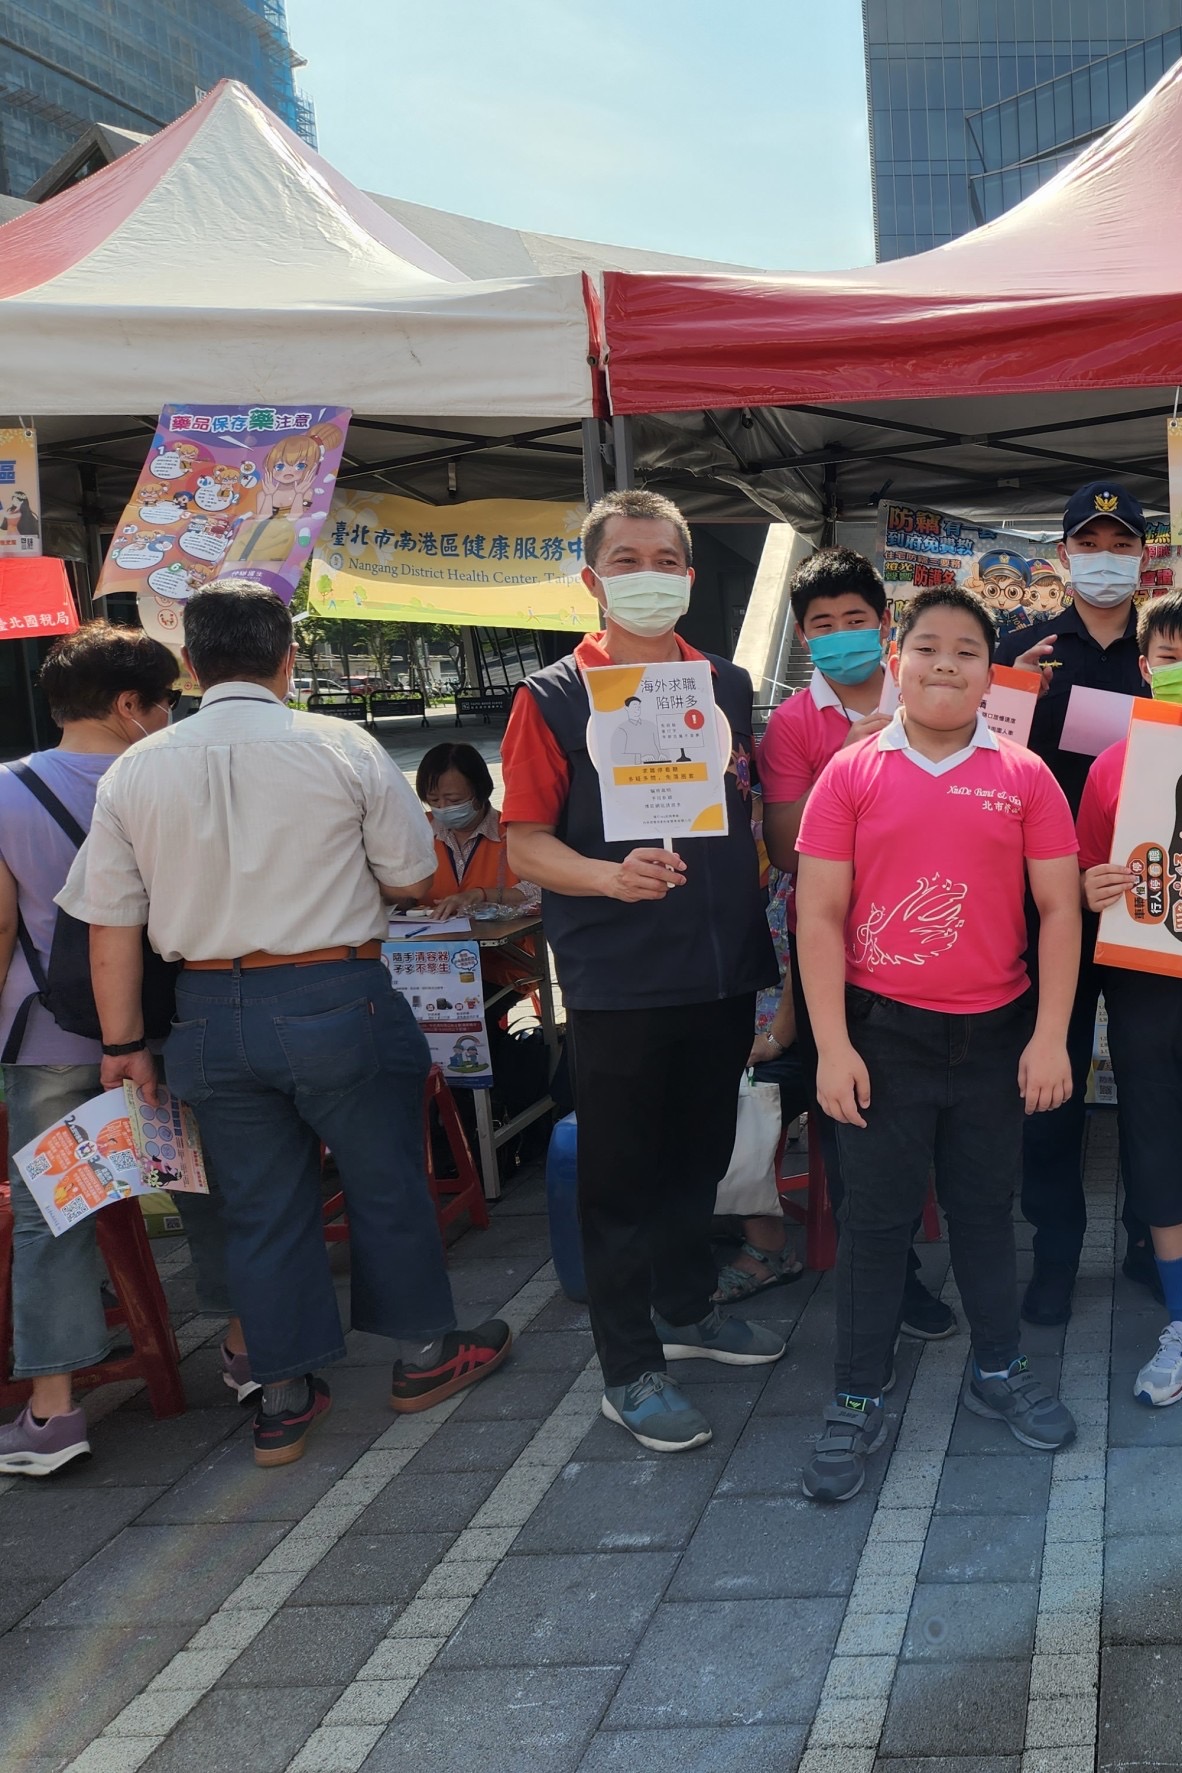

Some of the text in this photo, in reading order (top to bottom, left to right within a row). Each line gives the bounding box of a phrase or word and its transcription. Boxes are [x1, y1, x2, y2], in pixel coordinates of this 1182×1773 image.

[170, 408, 312, 432] 藥品保存藥注意
[332, 521, 584, 562] 臺北市南港區健康服務中
[886, 532, 975, 556] 到府免費教
[349, 557, 399, 578] Nangang
[401, 563, 450, 581] District
[448, 569, 490, 584] Health
[641, 677, 697, 693] 海外求職
[656, 694, 698, 710] 陷阱多
[974, 787, 997, 798] Band
